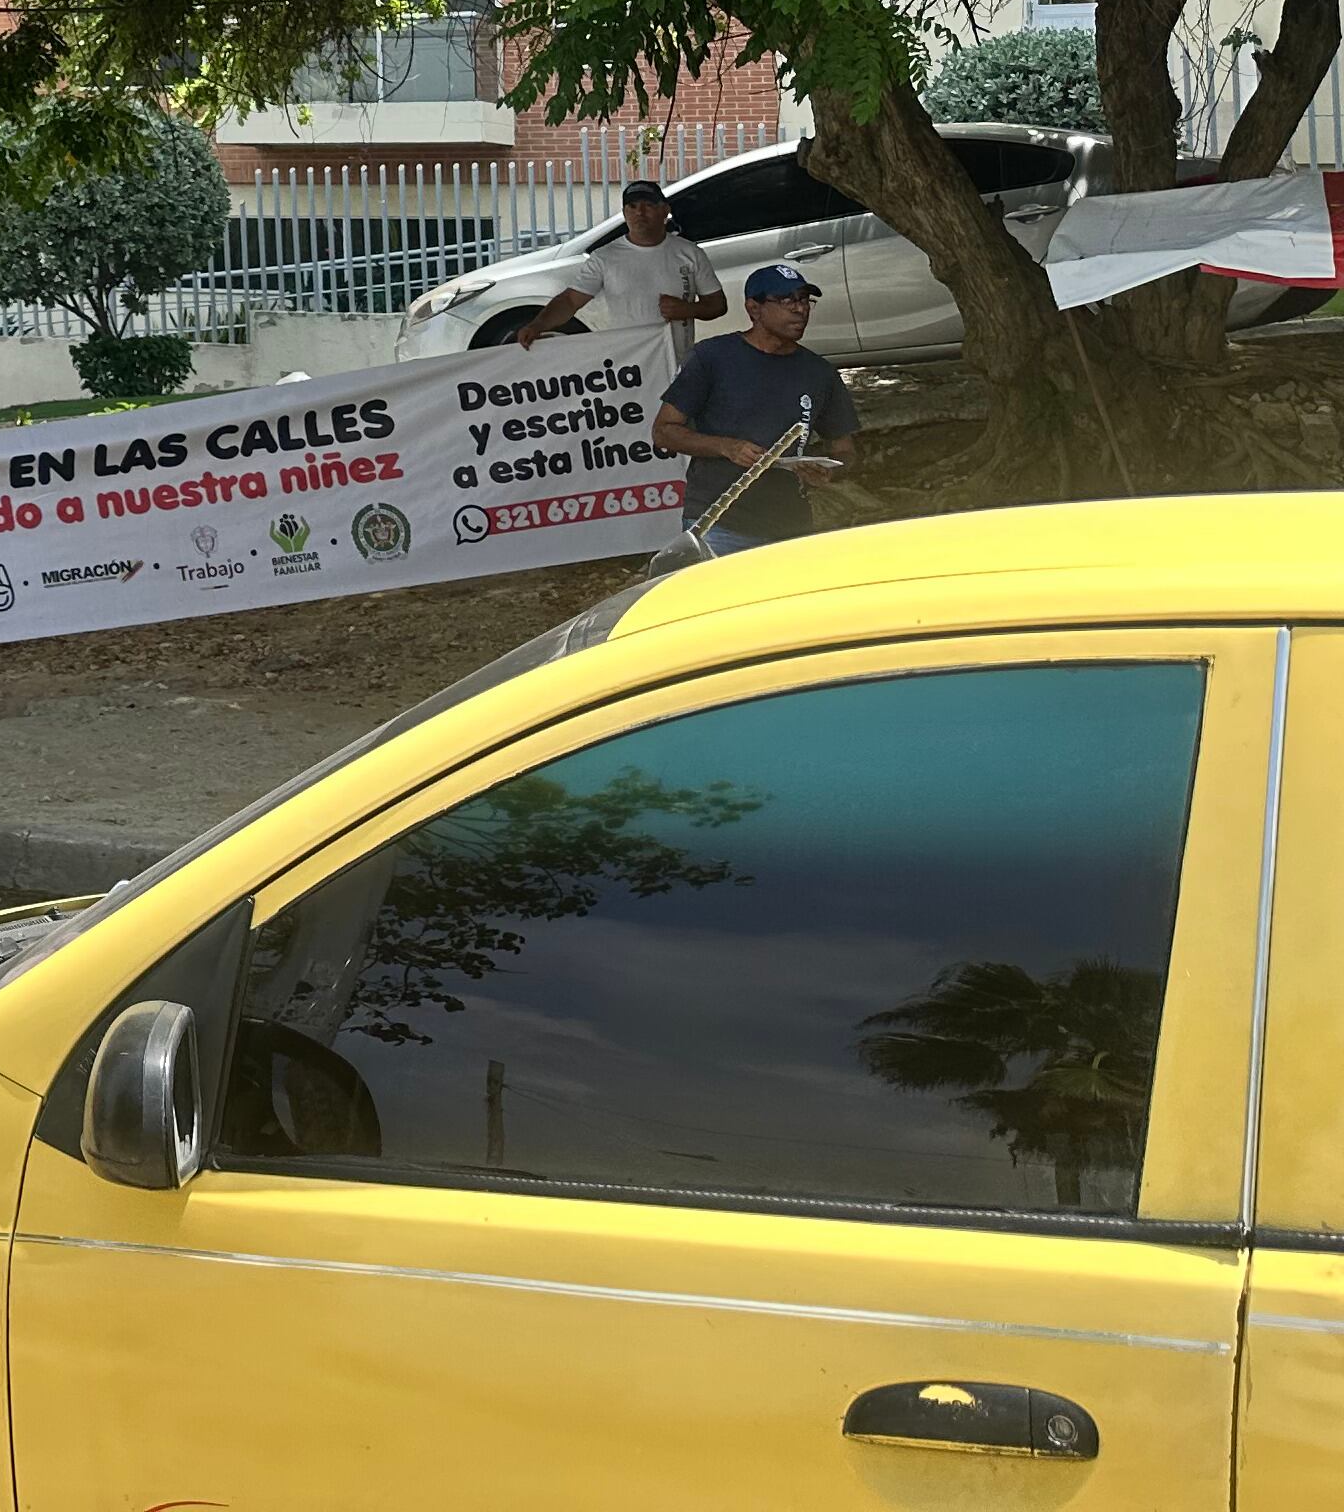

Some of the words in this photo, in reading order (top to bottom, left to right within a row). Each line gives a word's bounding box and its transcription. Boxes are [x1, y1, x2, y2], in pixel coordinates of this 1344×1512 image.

[457, 358, 643, 412] Denuncia
[8, 448, 76, 489] EN
[93, 432, 188, 478] LAS
[205, 398, 396, 460] CALLES
[468, 422, 492, 456] y
[502, 397, 645, 442] escribe
[56, 496, 85, 524] a
[97, 471, 269, 520] nuestra
[278, 451, 405, 495] niñez
[452, 464, 479, 489] a
[489, 448, 573, 484] esta
[495, 503, 542, 531] 321
[546, 495, 597, 522] 697
[602, 489, 640, 515] 66
[643, 483, 681, 509] 86
[41, 558, 133, 584] MIGRACIÓN
[176, 558, 245, 581] Trabajo
[271, 551, 320, 566] BIENESTAR
